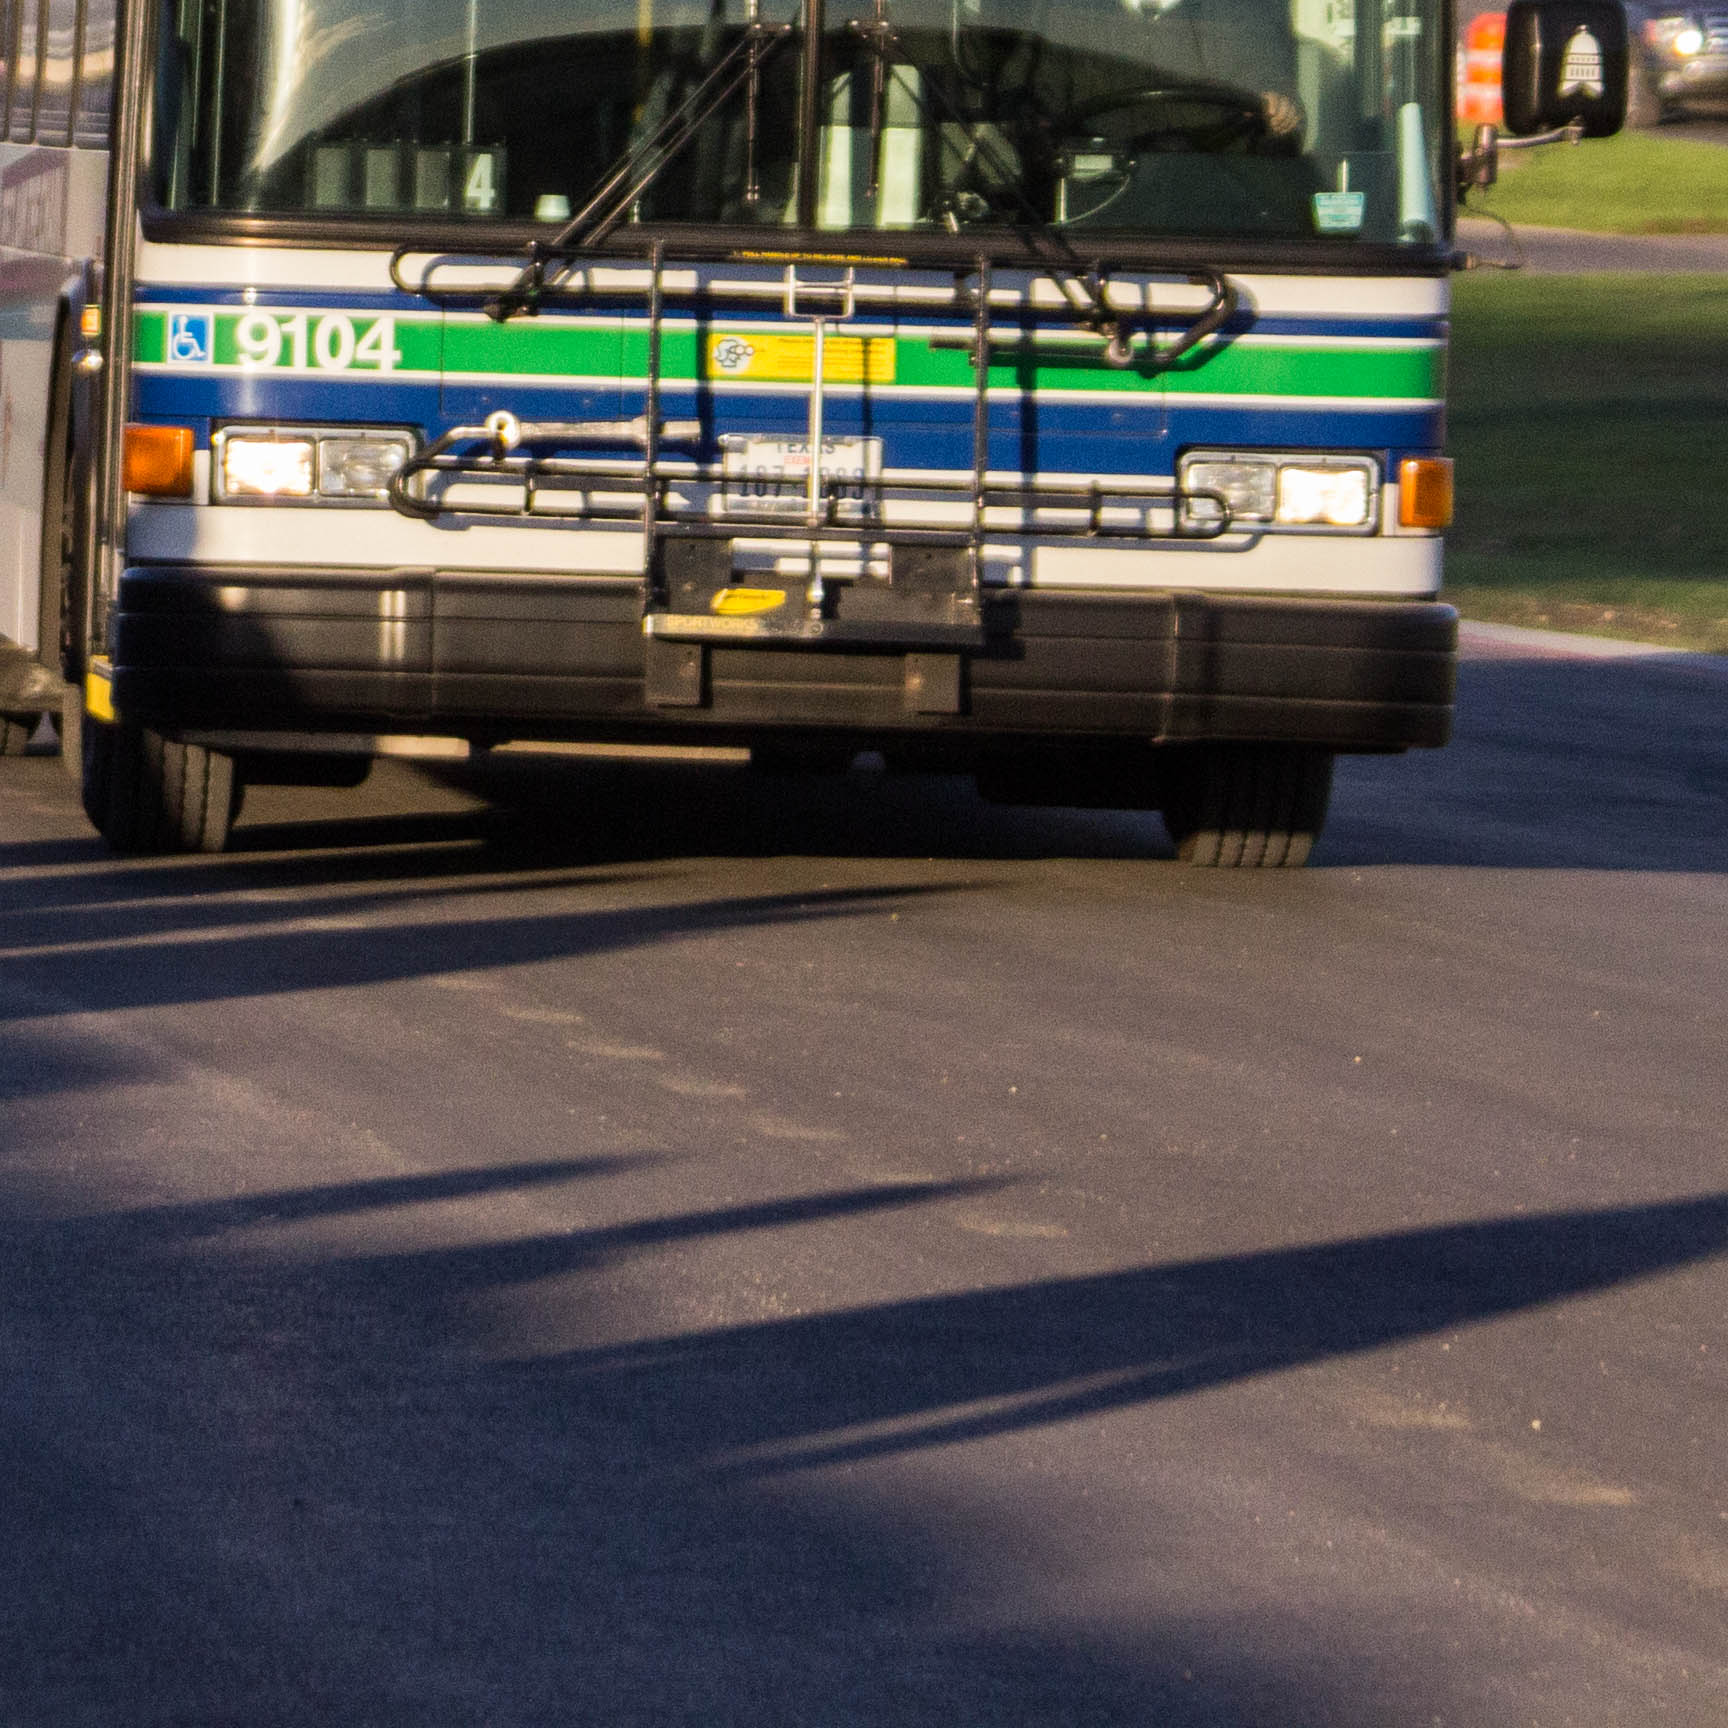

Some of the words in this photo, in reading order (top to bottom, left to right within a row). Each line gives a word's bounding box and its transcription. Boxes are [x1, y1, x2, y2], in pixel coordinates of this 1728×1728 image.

[464, 153, 495, 209] 4
[236, 312, 402, 371] 9104
[777, 442, 836, 454] TEXS
